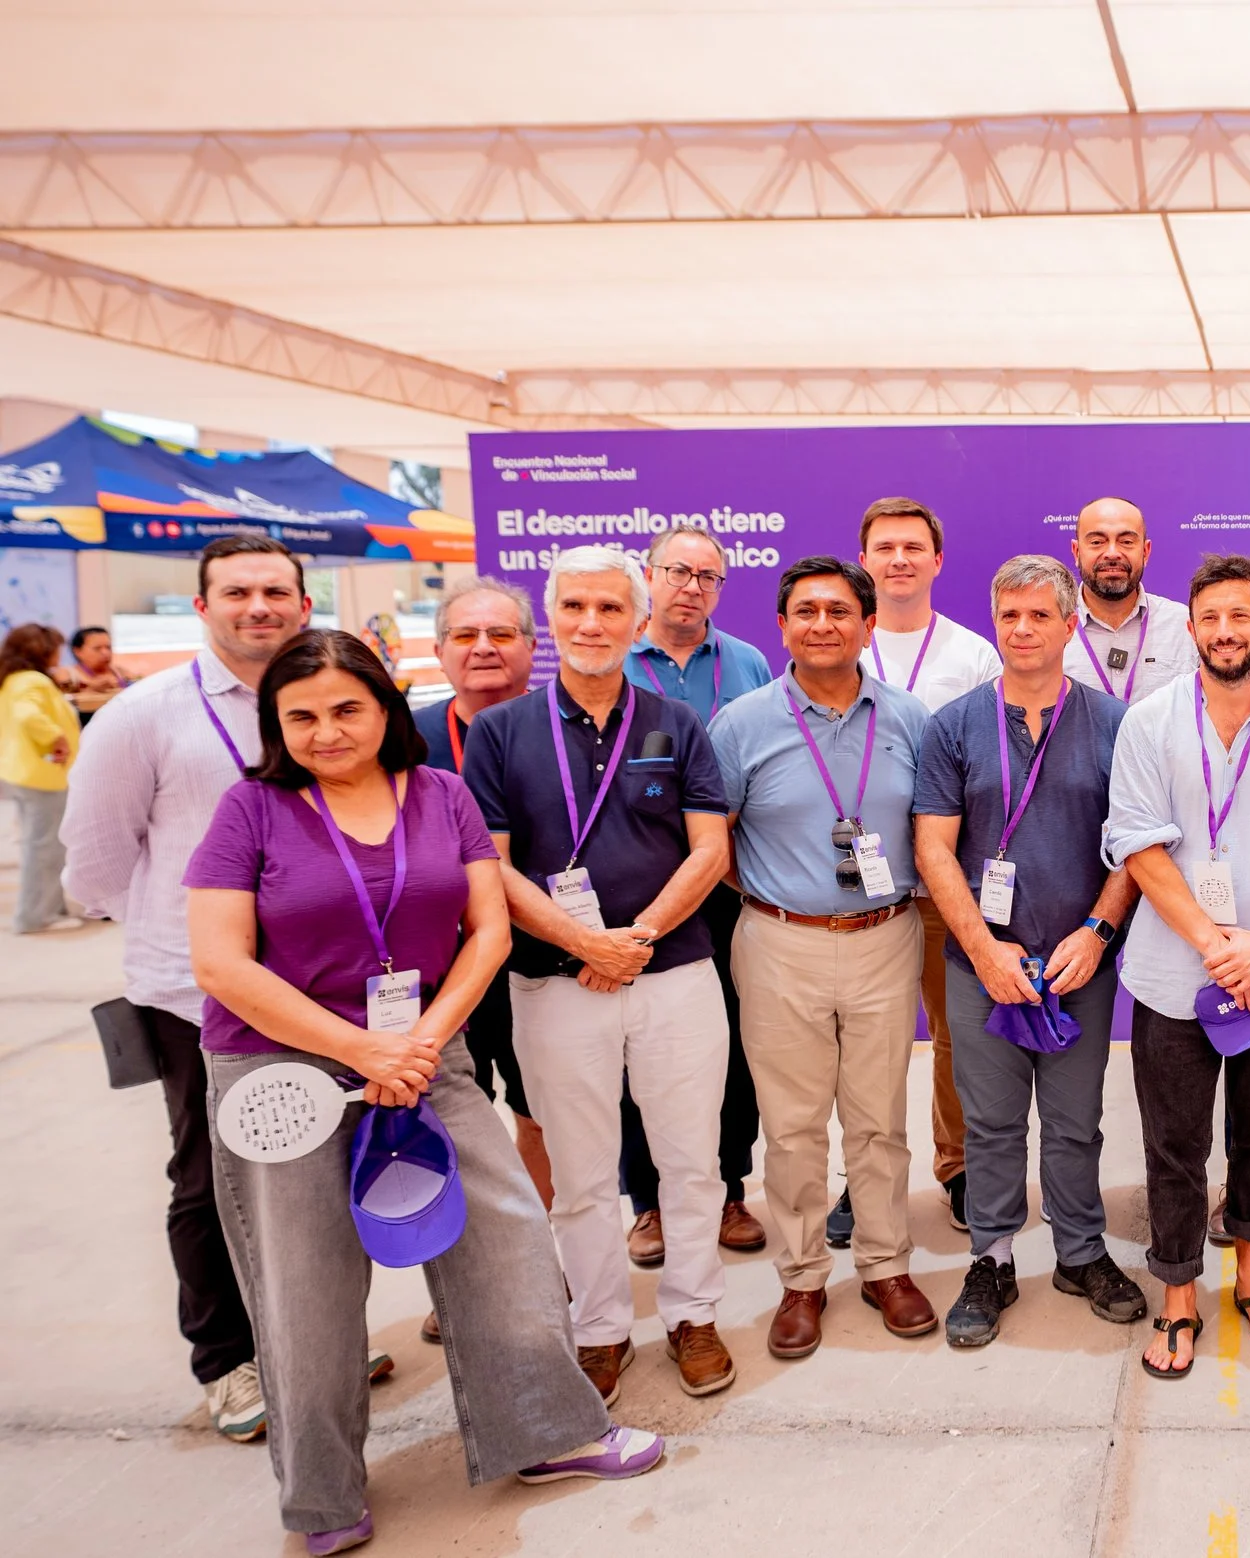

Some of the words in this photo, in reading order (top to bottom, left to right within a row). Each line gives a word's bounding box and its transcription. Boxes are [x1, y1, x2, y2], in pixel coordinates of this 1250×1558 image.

[493, 456, 553, 469] Encuentro
[554, 454, 608, 468] Nacional
[501, 469, 519, 481] de
[530, 468, 600, 481] Vinculación
[600, 467, 637, 480] Social
[497, 508, 525, 537] El
[526, 507, 668, 536] desarrollo
[671, 513, 708, 531] no
[710, 506, 785, 533] tiene
[1043, 514, 1062, 523] ¿Qué
[1192, 513, 1212, 522] ¿Qué
[1228, 514, 1241, 522] que
[498, 549, 537, 571] un
[725, 540, 780, 568] nico
